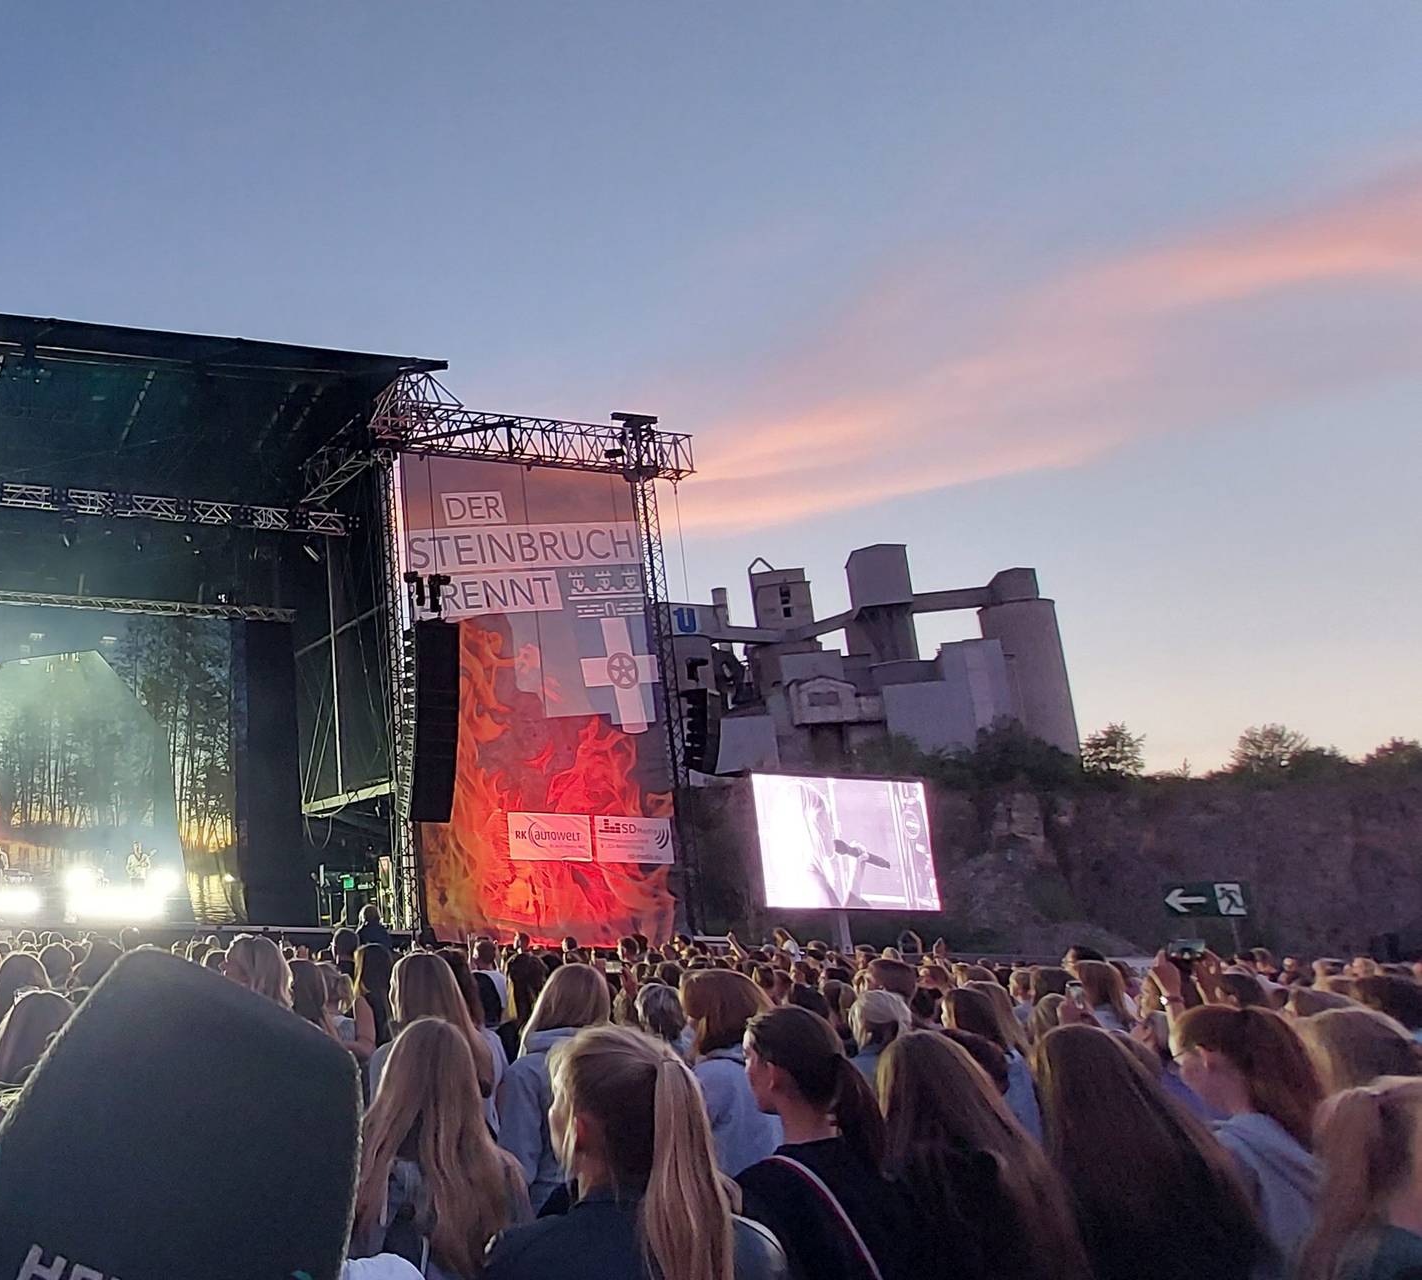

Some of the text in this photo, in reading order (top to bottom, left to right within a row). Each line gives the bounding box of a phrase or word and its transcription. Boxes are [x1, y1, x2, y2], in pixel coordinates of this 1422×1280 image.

[445, 495, 503, 521] DER
[409, 528, 635, 569] STEINBRUCH
[416, 576, 553, 611] RENNT
[514, 830, 528, 840] RK
[621, 823, 637, 834] SD
